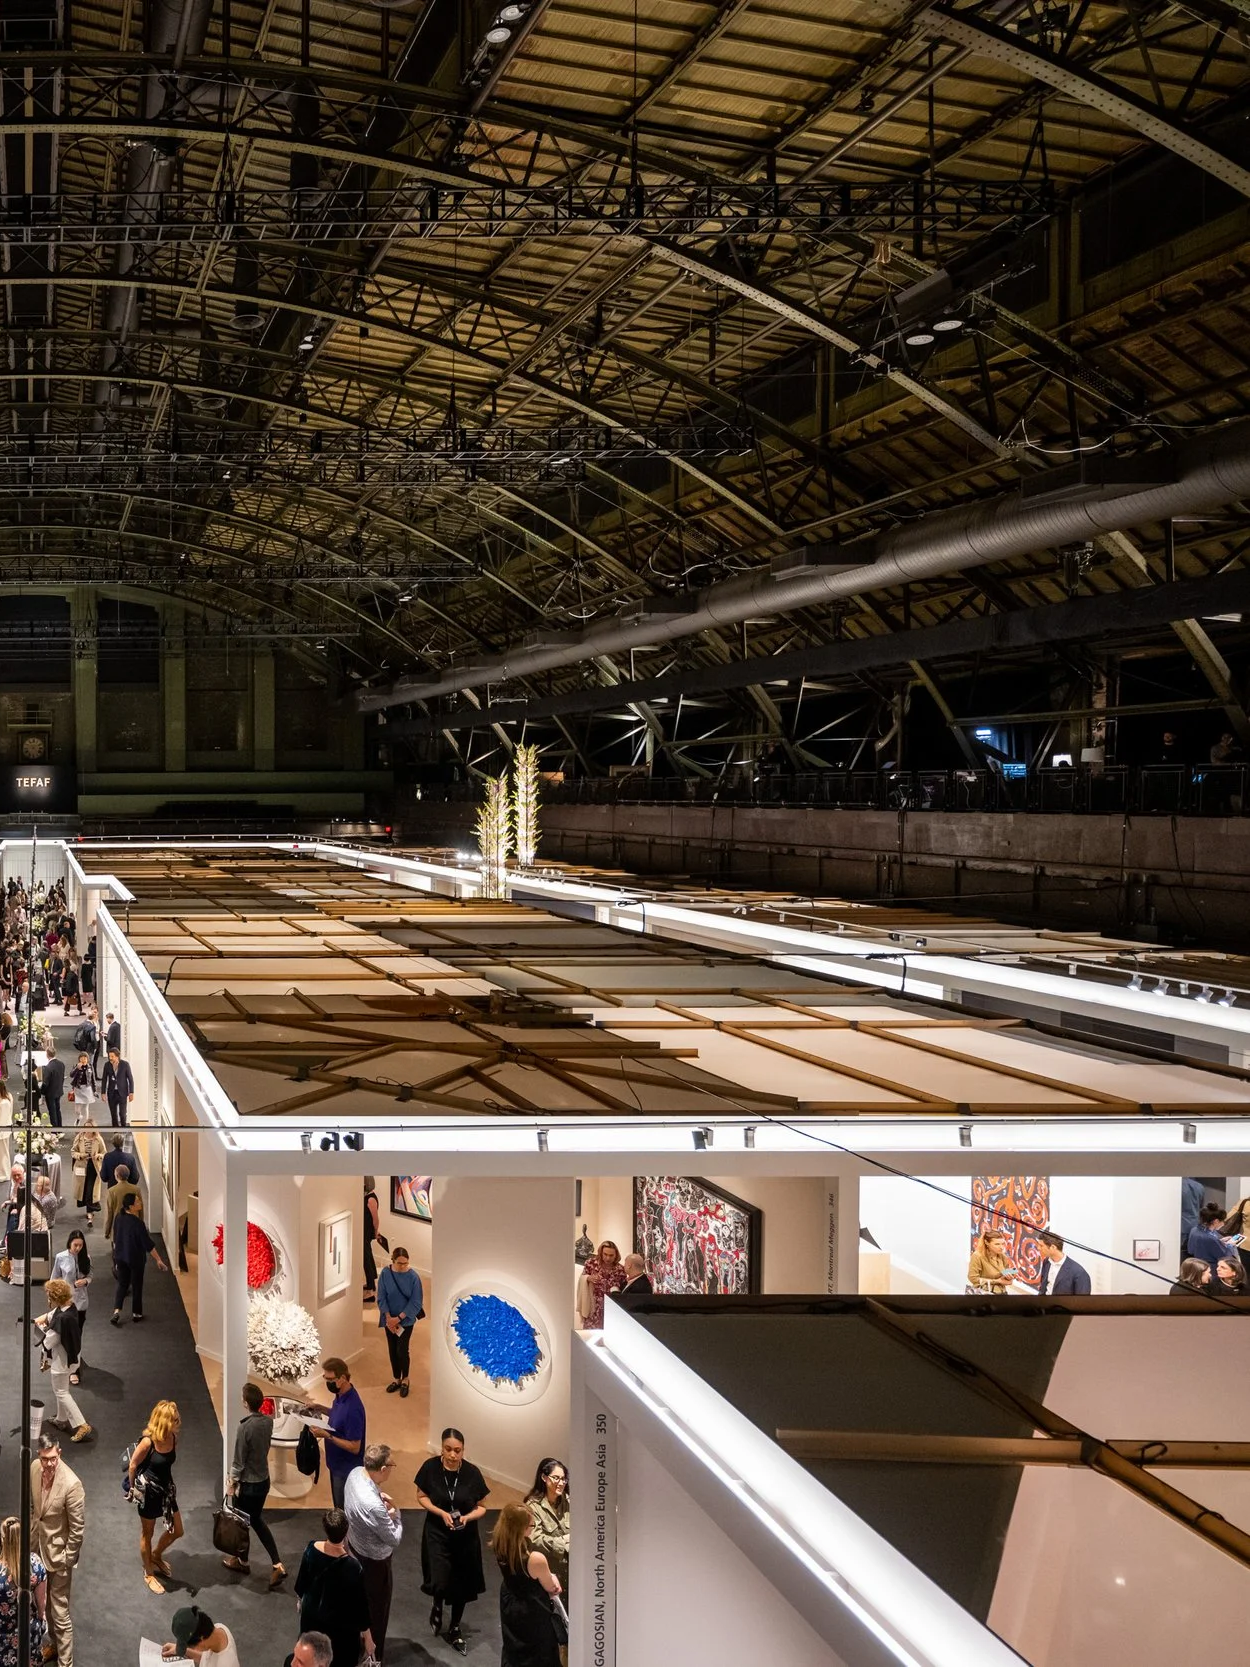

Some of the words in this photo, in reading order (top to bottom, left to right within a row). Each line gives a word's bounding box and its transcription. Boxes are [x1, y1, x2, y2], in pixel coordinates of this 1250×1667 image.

[16, 777, 51, 787] TEFAF
[596, 1413, 607, 1434] 350
[595, 1444, 606, 1468] Asia
[595, 1471, 608, 1511] Europe
[594, 1515, 606, 1561] America
[594, 1564, 605, 1597] North
[594, 1600, 607, 1667] GAGOSIAN,
